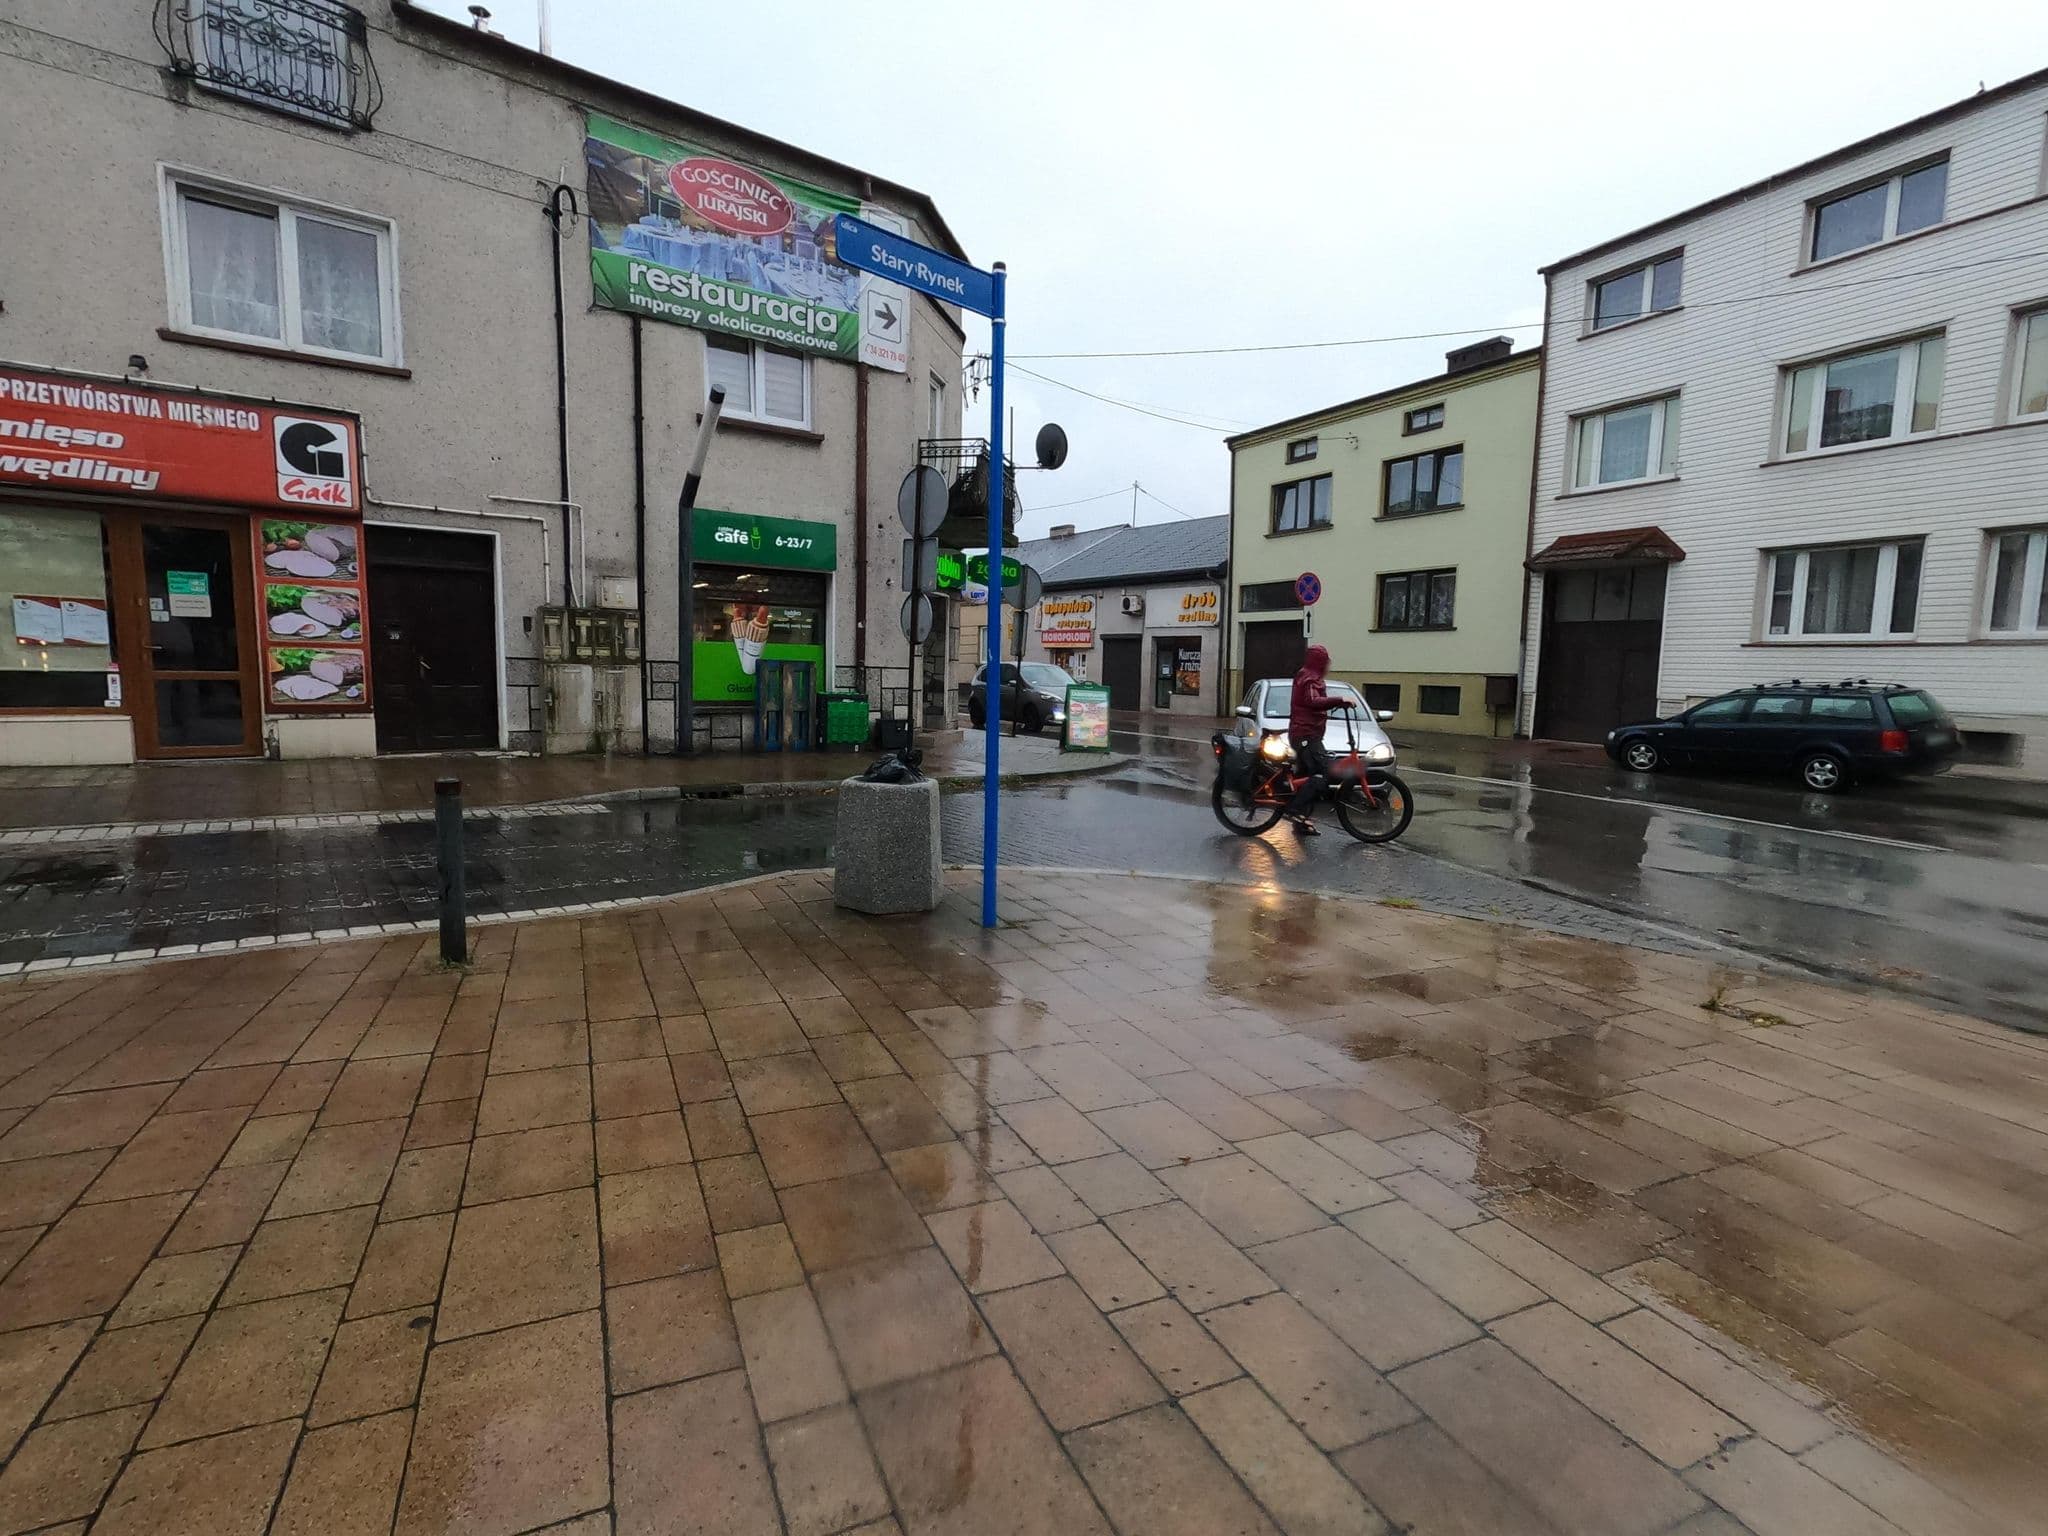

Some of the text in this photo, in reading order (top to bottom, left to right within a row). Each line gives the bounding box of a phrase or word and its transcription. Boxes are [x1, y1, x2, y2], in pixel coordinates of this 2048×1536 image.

[681, 166, 782, 210] GOŚCINIEC
[697, 193, 768, 227] JURAJSKI
[871, 244, 965, 295] Stary Rynek
[629, 260, 838, 335] restauracja
[629, 289, 838, 351] imprezy okolicznościowe
[0, 377, 260, 432] PRZETWÓRSTWA MIĘSNEGO
[0, 419, 124, 448] mięso
[0, 455, 160, 491] wędliny
[283, 478, 348, 503] Gaik
[775, 535, 813, 549] 6-23/7
[1182, 591, 1217, 609] drób
